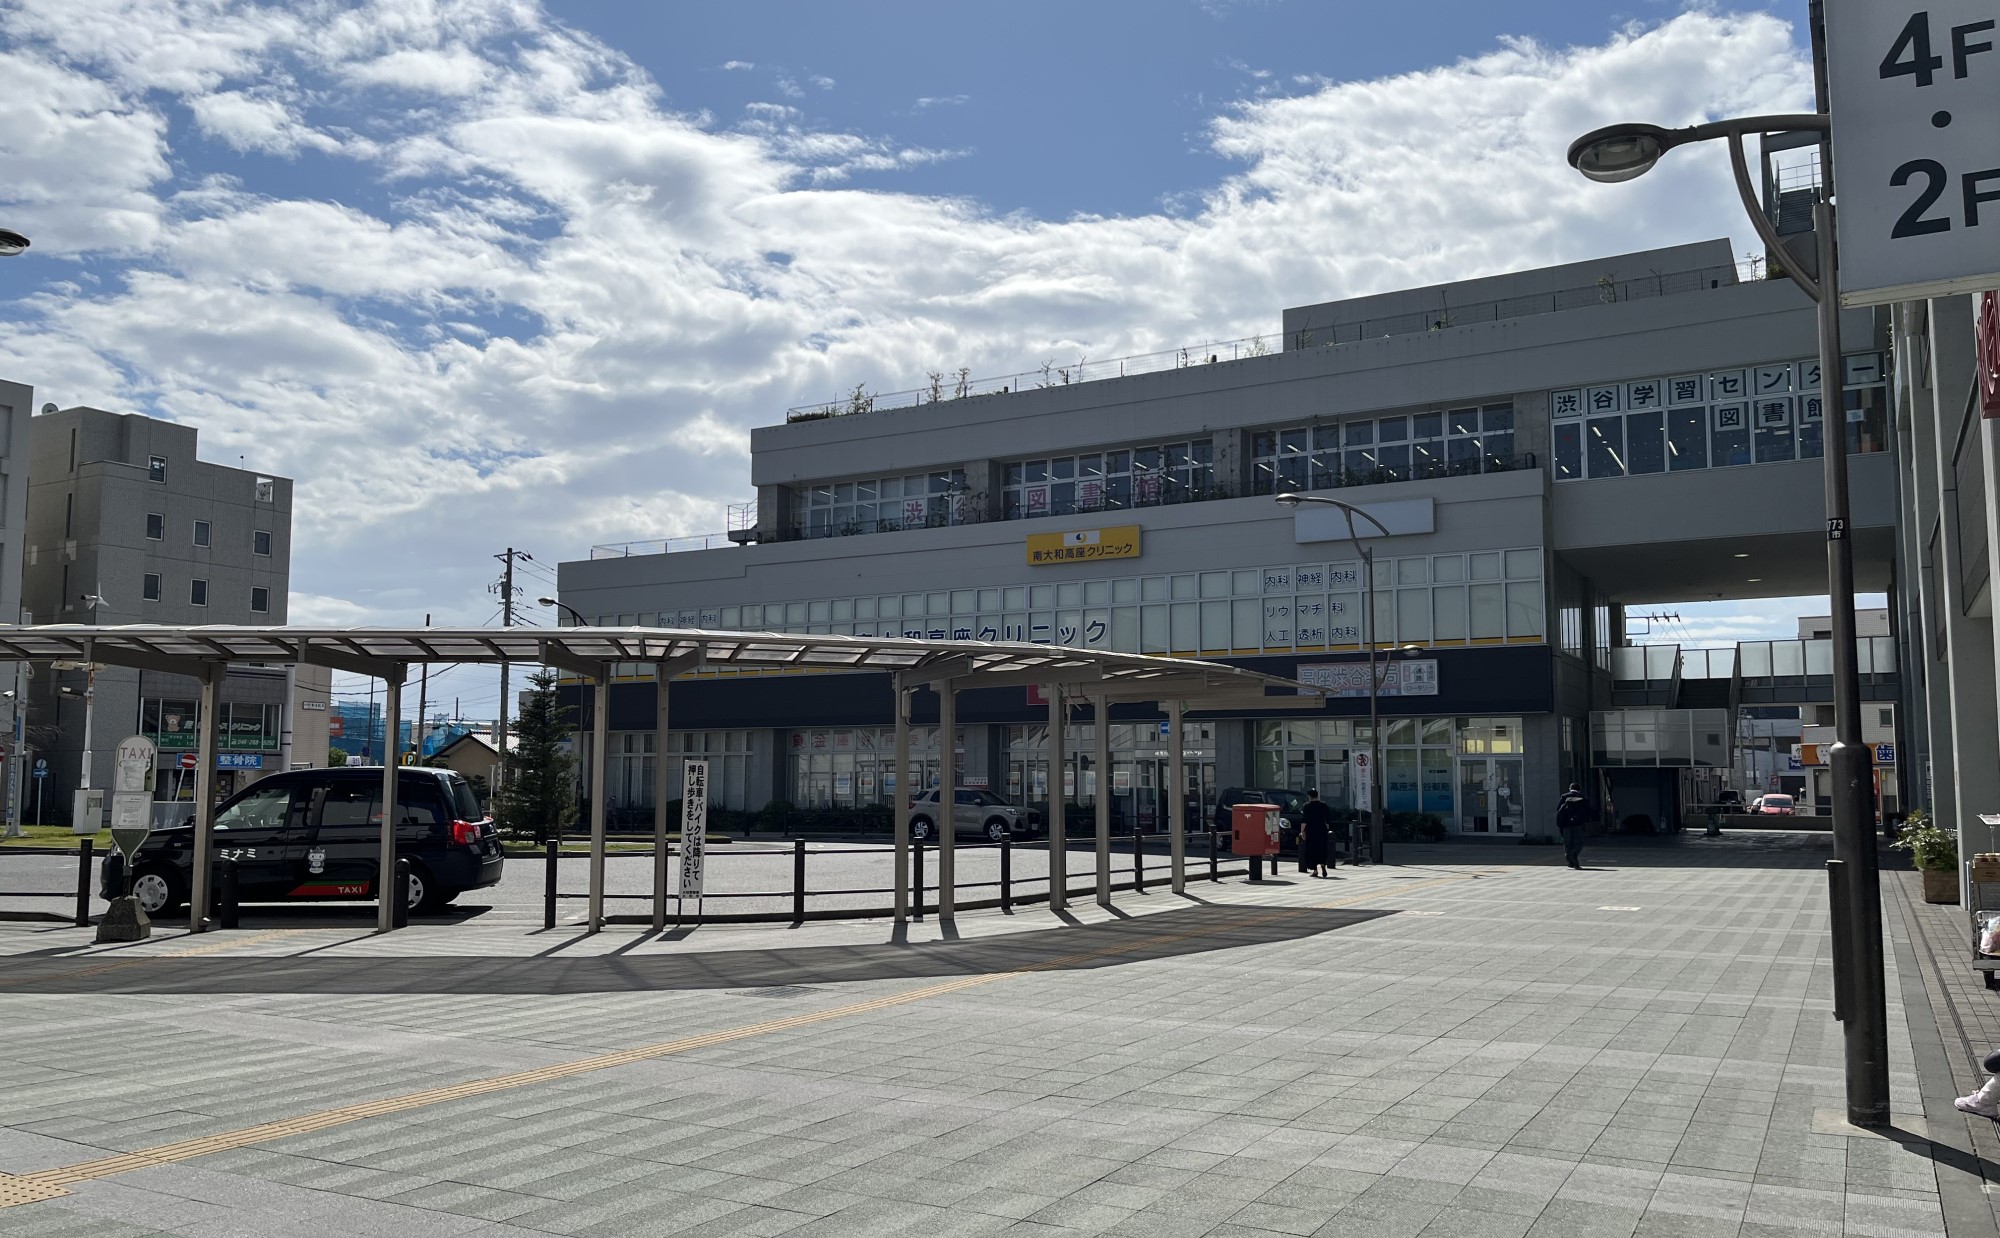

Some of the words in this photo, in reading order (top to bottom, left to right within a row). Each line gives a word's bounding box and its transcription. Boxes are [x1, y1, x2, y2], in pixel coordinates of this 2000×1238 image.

[1878, 10, 1996, 88] 4F
[1889, 158, 2000, 240] 2F
[1032, 542, 1133, 562] 南大和高座クリニック
[120, 747, 152, 760] TAXI
[219, 755, 258, 766] 整骨院
[683, 764, 697, 889] 押し歩きをしてください
[220, 848, 257, 860] ミナミ
[338, 886, 362, 894] TAXI
